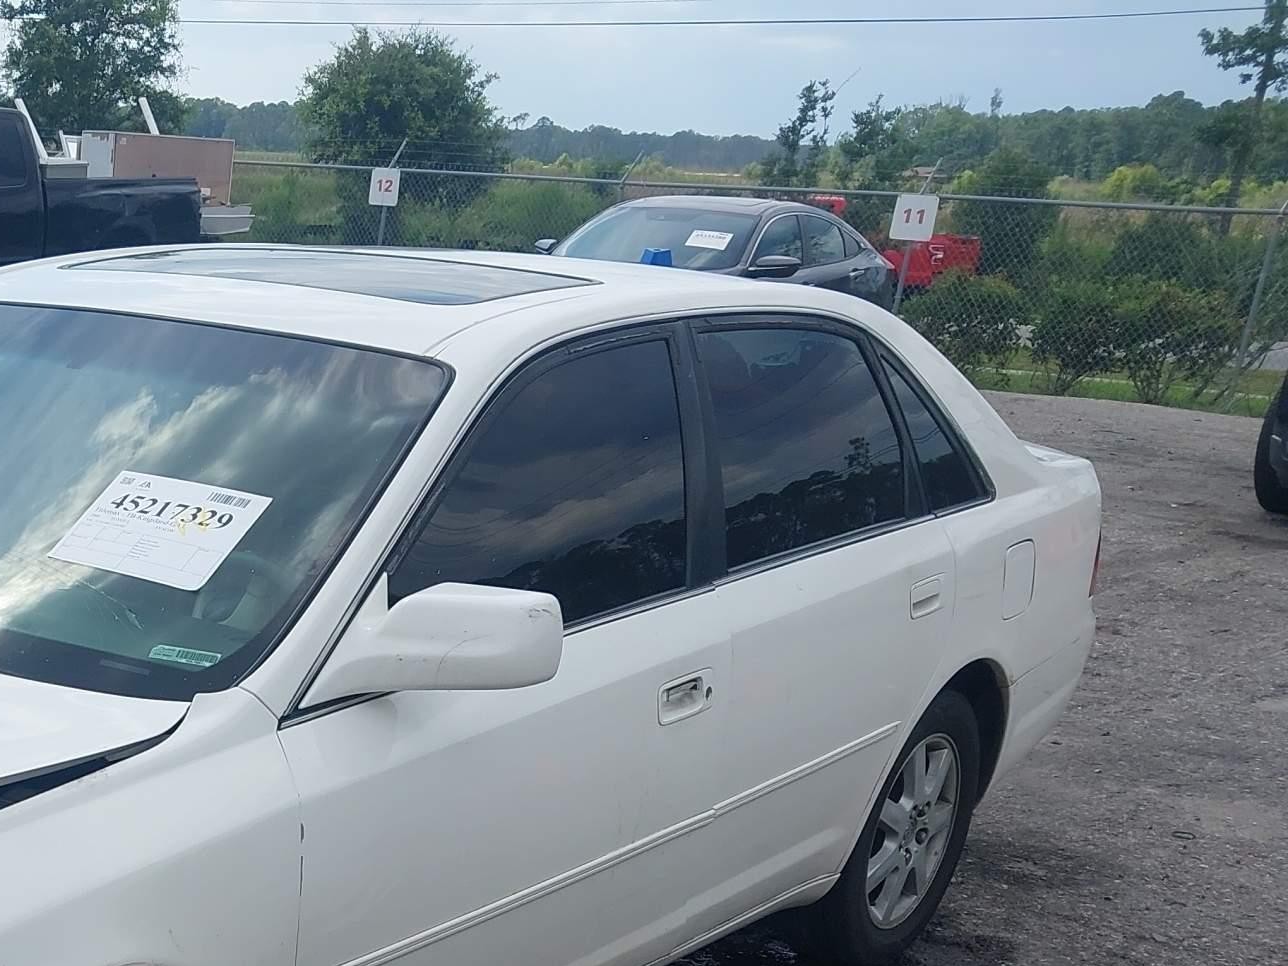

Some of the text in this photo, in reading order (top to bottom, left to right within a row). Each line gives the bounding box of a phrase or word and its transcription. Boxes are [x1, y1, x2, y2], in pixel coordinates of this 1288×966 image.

[376, 178, 394, 193] 12
[903, 208, 926, 225] 11
[110, 493, 235, 529] 45217329
